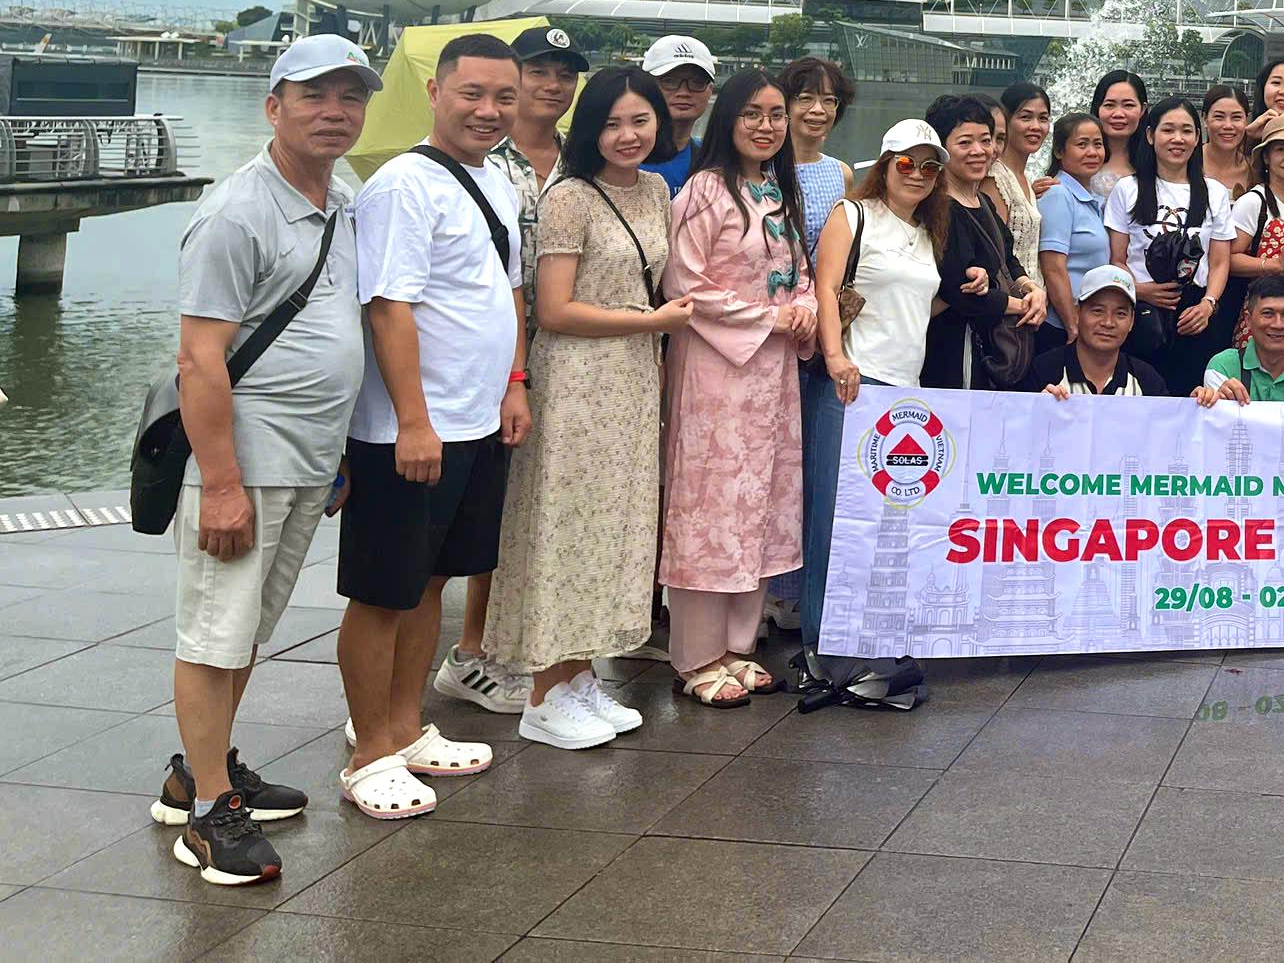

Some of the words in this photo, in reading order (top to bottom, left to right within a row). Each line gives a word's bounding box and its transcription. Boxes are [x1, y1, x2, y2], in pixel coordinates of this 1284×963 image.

[891, 411, 928, 423] MERMAID
[869, 433, 881, 472] MARITIME
[892, 456, 923, 465] SOLAS
[933, 434, 945, 472] VIETNAM
[904, 486, 921, 497] LTD
[976, 471, 1121, 497] WELCOME
[1129, 474, 1265, 497] MERMAID
[946, 518, 1276, 564] SINGAPORE
[1154, 583, 1233, 611] 29/08
